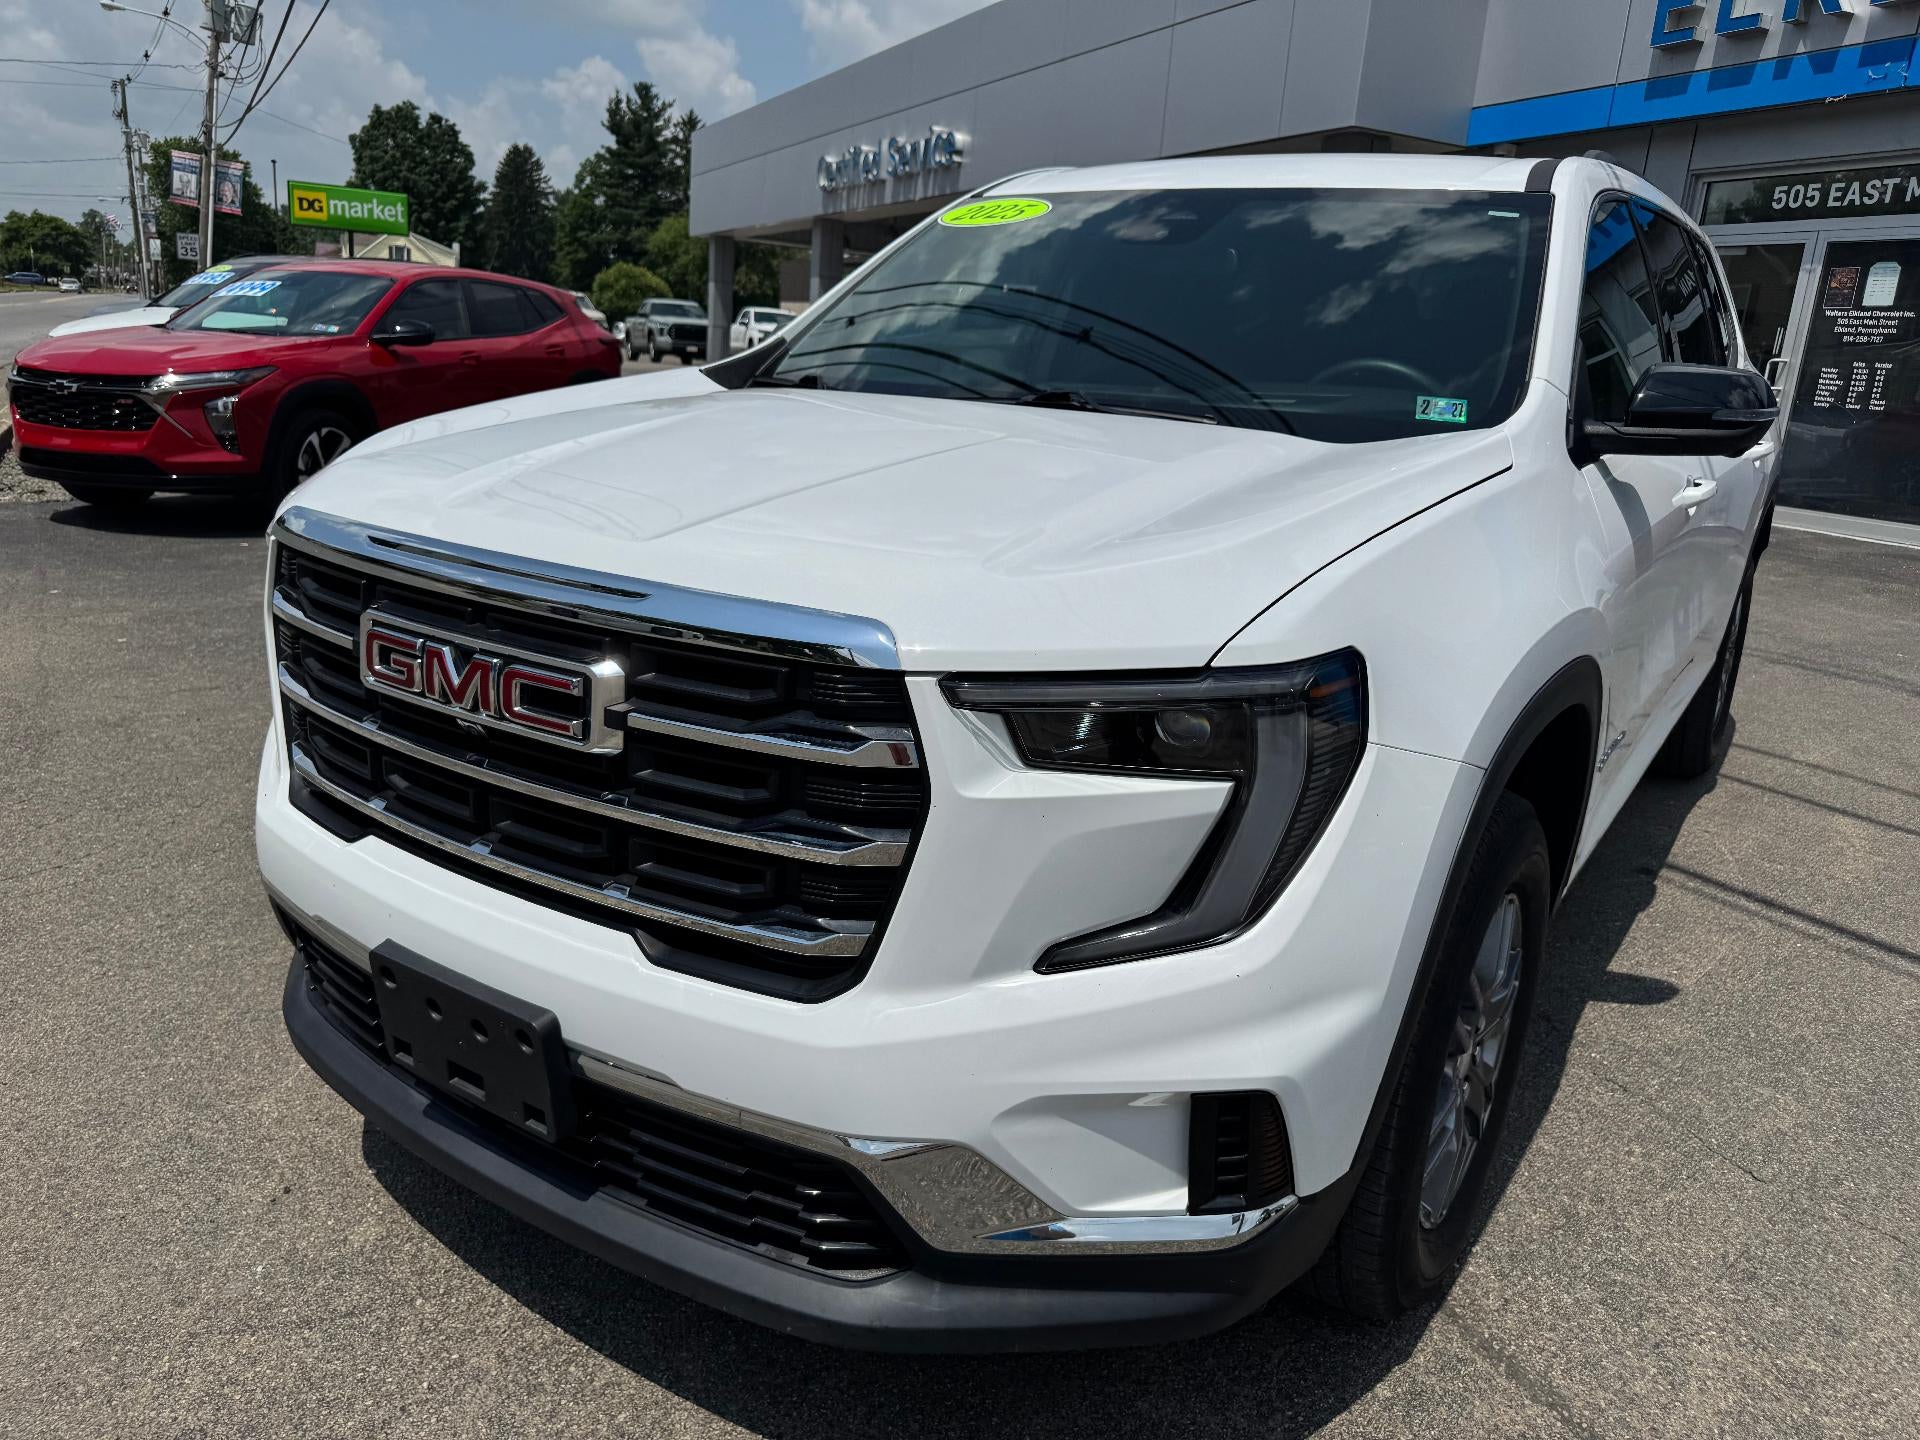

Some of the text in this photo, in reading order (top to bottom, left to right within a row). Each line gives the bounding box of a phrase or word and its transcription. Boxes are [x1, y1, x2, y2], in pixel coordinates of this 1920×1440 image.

[887, 127, 962, 178] Service
[1771, 183, 1823, 210] 505
[1827, 177, 1901, 208] EAST
[297, 197, 404, 223] DG market
[951, 204, 1041, 222] 2025
[180, 246, 198, 257] 35
[1452, 402, 1464, 418] 27
[366, 627, 584, 739] GMC
